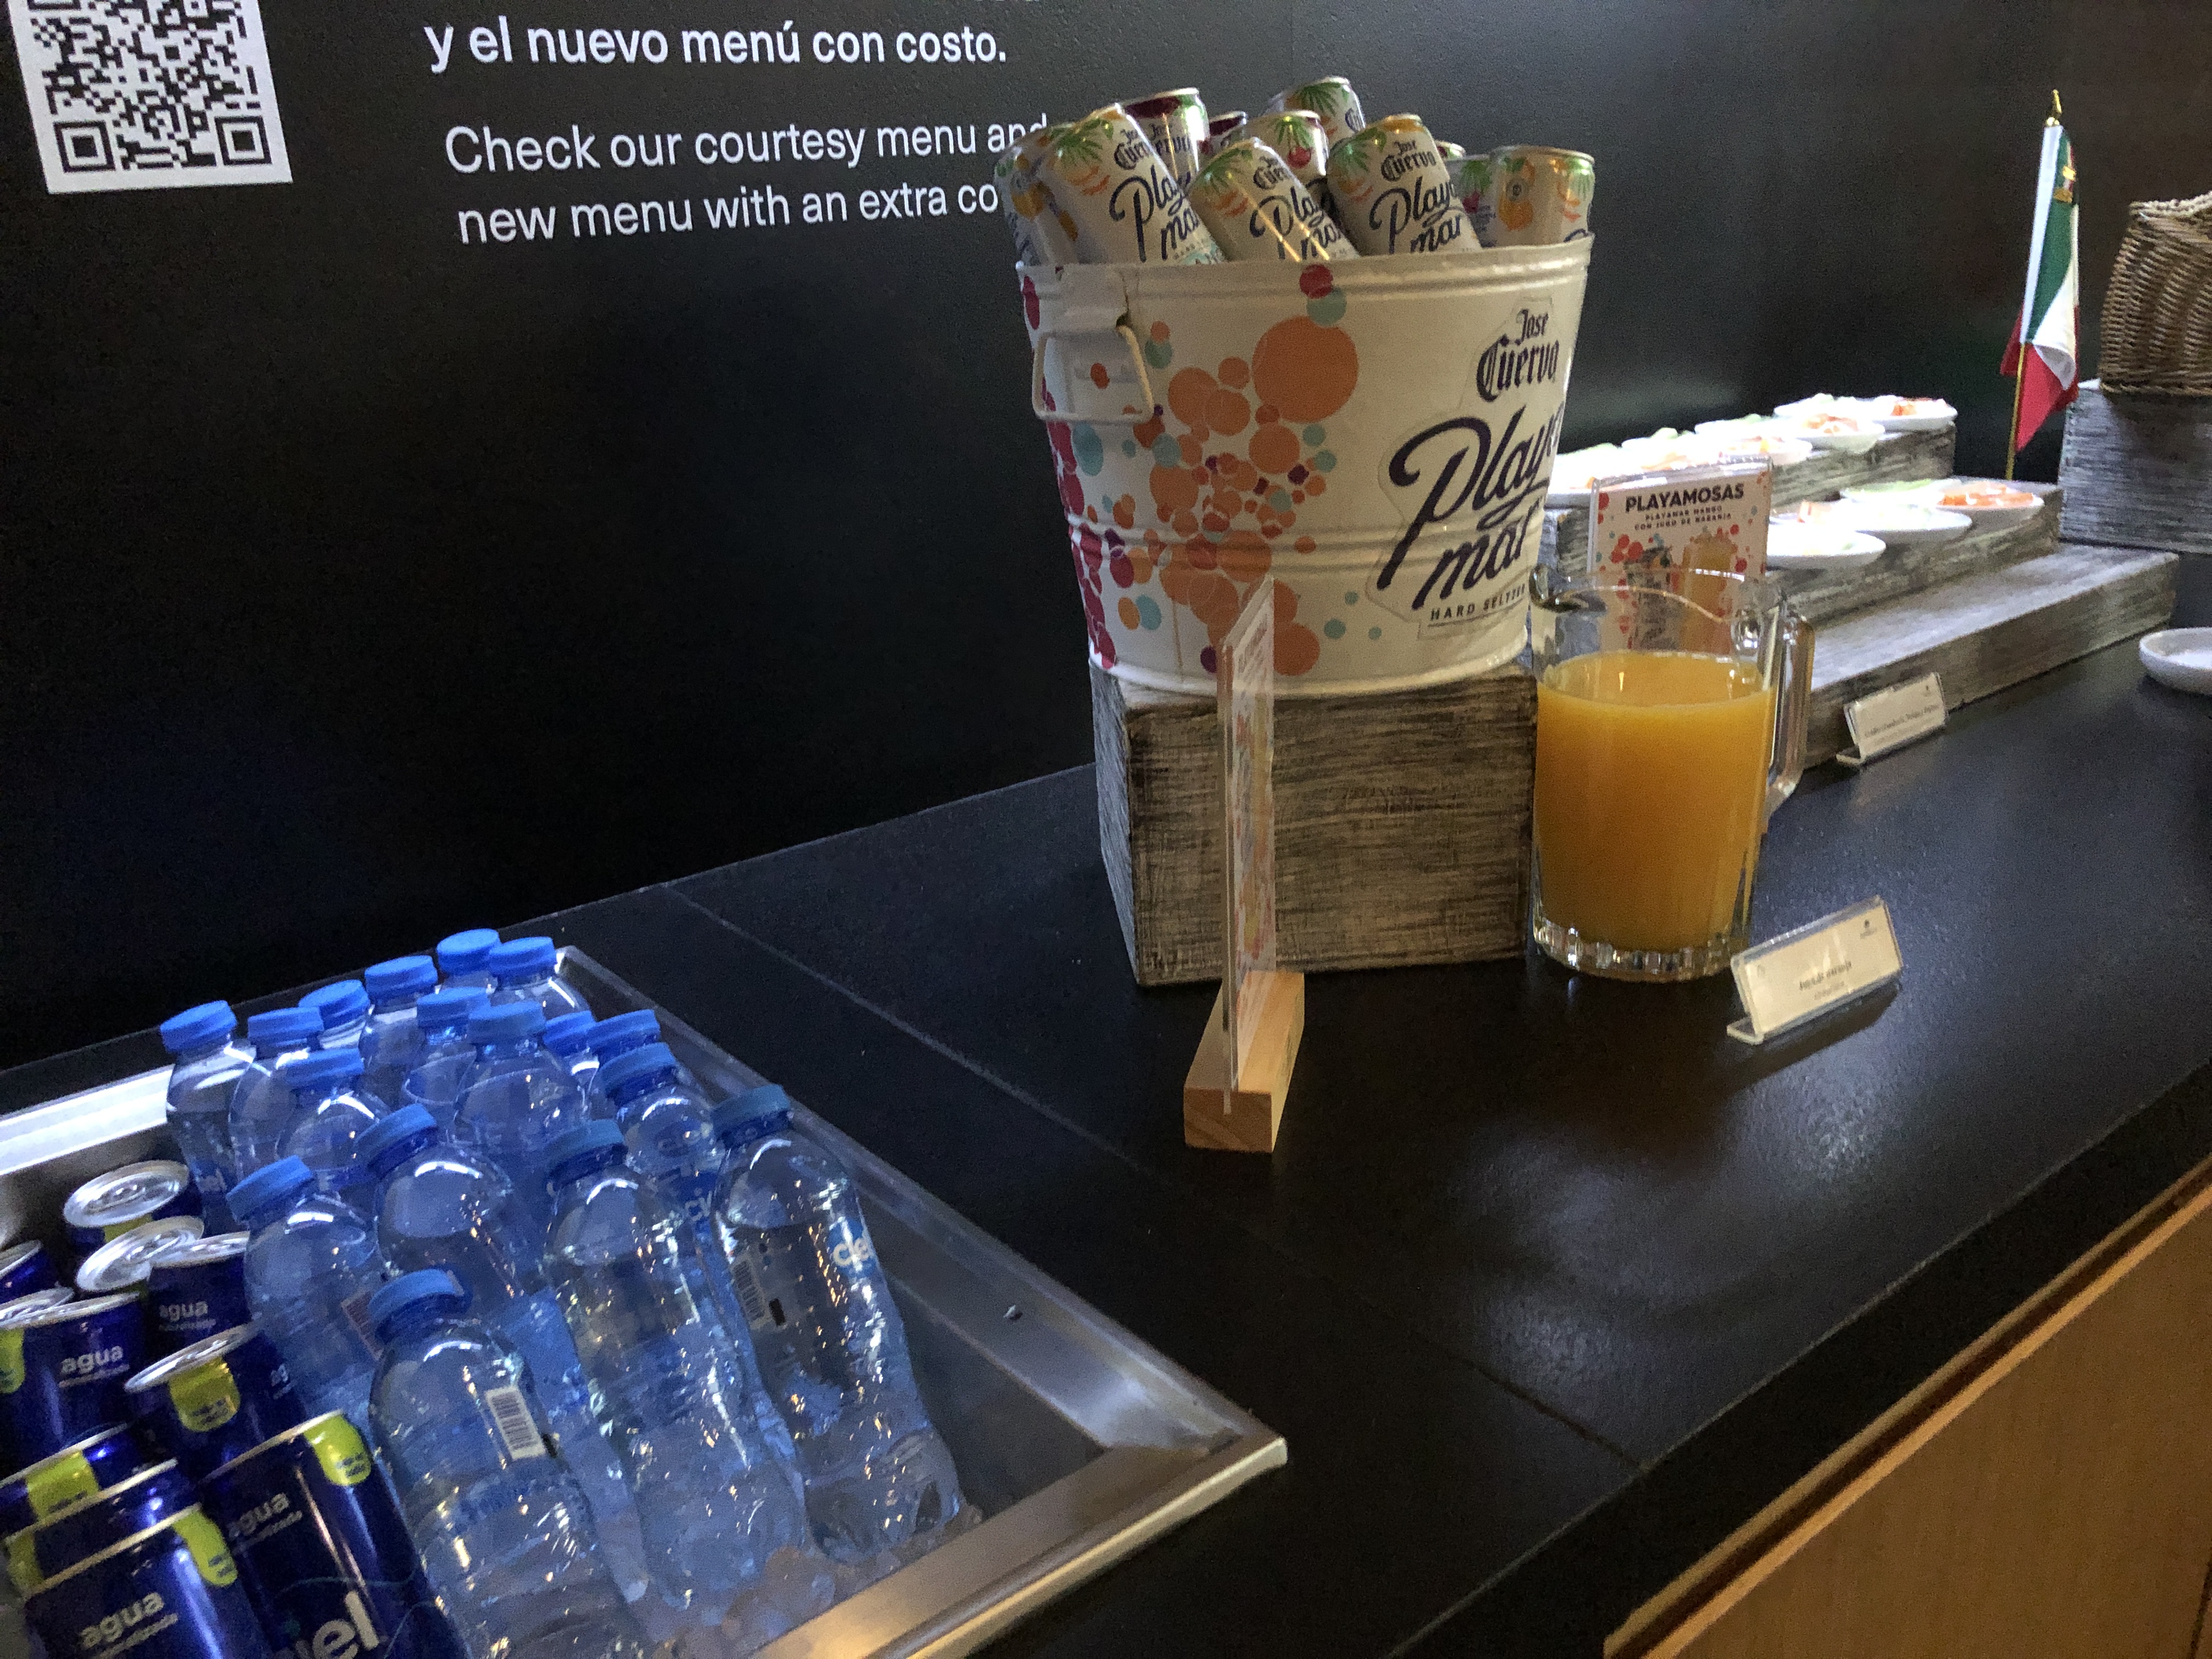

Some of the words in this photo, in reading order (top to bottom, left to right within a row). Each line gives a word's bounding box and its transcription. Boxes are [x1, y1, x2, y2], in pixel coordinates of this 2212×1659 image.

[424, 25, 454, 73] y
[469, 15, 513, 63] el
[527, 28, 668, 64] nuevo
[681, 20, 800, 64] menú
[812, 31, 885, 64] con
[896, 25, 1007, 63] costo.
[445, 125, 601, 173] Check
[610, 133, 682, 167] our
[695, 123, 866, 168] courtesy
[877, 125, 976, 157] menu
[458, 206, 556, 244] new
[571, 199, 693, 237] menu
[703, 185, 790, 228] with
[802, 191, 848, 223] an
[859, 182, 947, 220] extra
[958, 184, 998, 213] co
[1477, 334, 1559, 402] Cuervo
[1625, 483, 1744, 514] PLAYAMOSAS
[1431, 602, 1476, 621] HARD
[158, 1300, 209, 1323] agua
[60, 1345, 124, 1375] agua
[78, 1592, 165, 1649] agua
